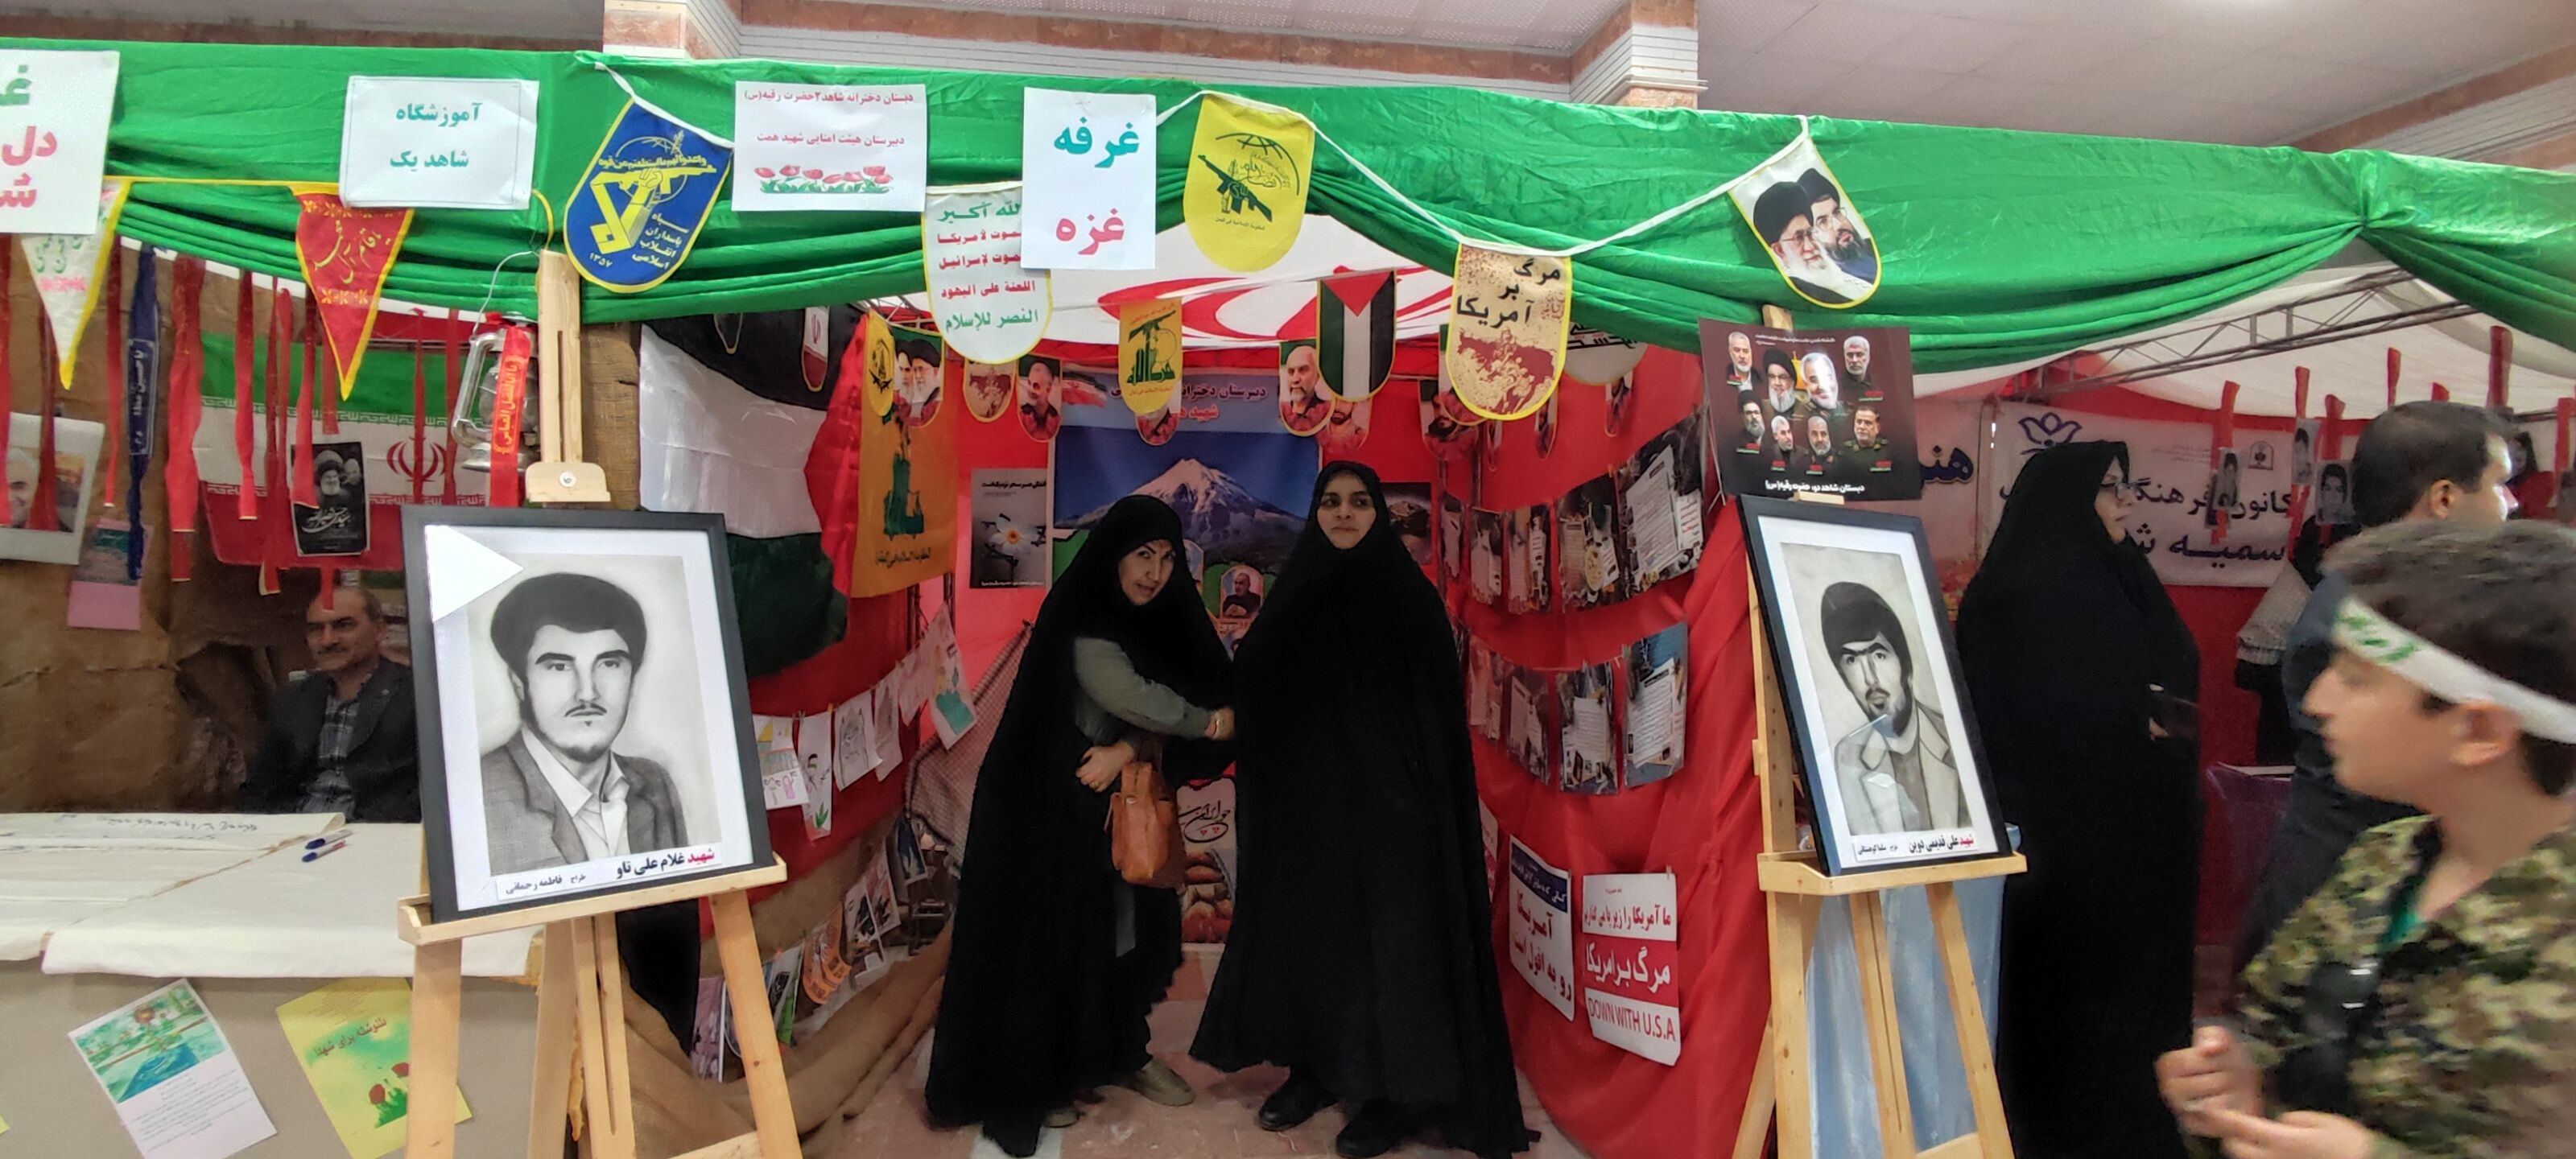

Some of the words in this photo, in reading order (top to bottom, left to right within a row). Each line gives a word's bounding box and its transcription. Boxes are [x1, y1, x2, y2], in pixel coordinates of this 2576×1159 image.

[847, 92, 881, 105] دخترانه
[884, 91, 914, 105] دبستان
[395, 102, 482, 127] آموزشگاه
[757, 133, 778, 142] همت
[782, 132, 804, 143] شهید
[864, 134, 906, 148] دبیرستان
[1054, 117, 1140, 168] غرفه
[390, 151, 418, 171] یک
[424, 150, 469, 168] شاهد
[645, 228, 683, 248] پاسداران
[1055, 208, 1125, 255] غزه
[639, 239, 677, 258] انقلاب
[589, 251, 614, 267] ۱۳۵۷
[631, 252, 671, 270] اسلامی
[1514, 259, 1561, 285] مرگ
[1498, 280, 1520, 300] بر
[997, 308, 1038, 328] النصر
[1456, 295, 1536, 328] آمریکا
[1219, 385, 1265, 400] دبیرستان
[1821, 483, 1839, 492] شاهد
[1839, 484, 1865, 494] دبستان
[2169, 535, 2285, 569] سمیه
[1947, 835, 1959, 850] علی
[1959, 835, 1974, 845] شهید
[661, 852, 685, 872] غلام
[687, 848, 715, 865] شهید
[616, 860, 632, 880] تاو
[634, 857, 658, 876] علی
[505, 880, 539, 896] رحمانی
[539, 876, 563, 887] فاطمه
[1632, 903, 1661, 932] آمریکا
[1662, 906, 1671, 926] ما
[1612, 957, 1632, 988] بر
[1633, 946, 1671, 994] مرگ
[1588, 997, 1615, 1025] DOWN
[1614, 1003, 1641, 1034] WITH
[1642, 1009, 1676, 1043] U.S.A
